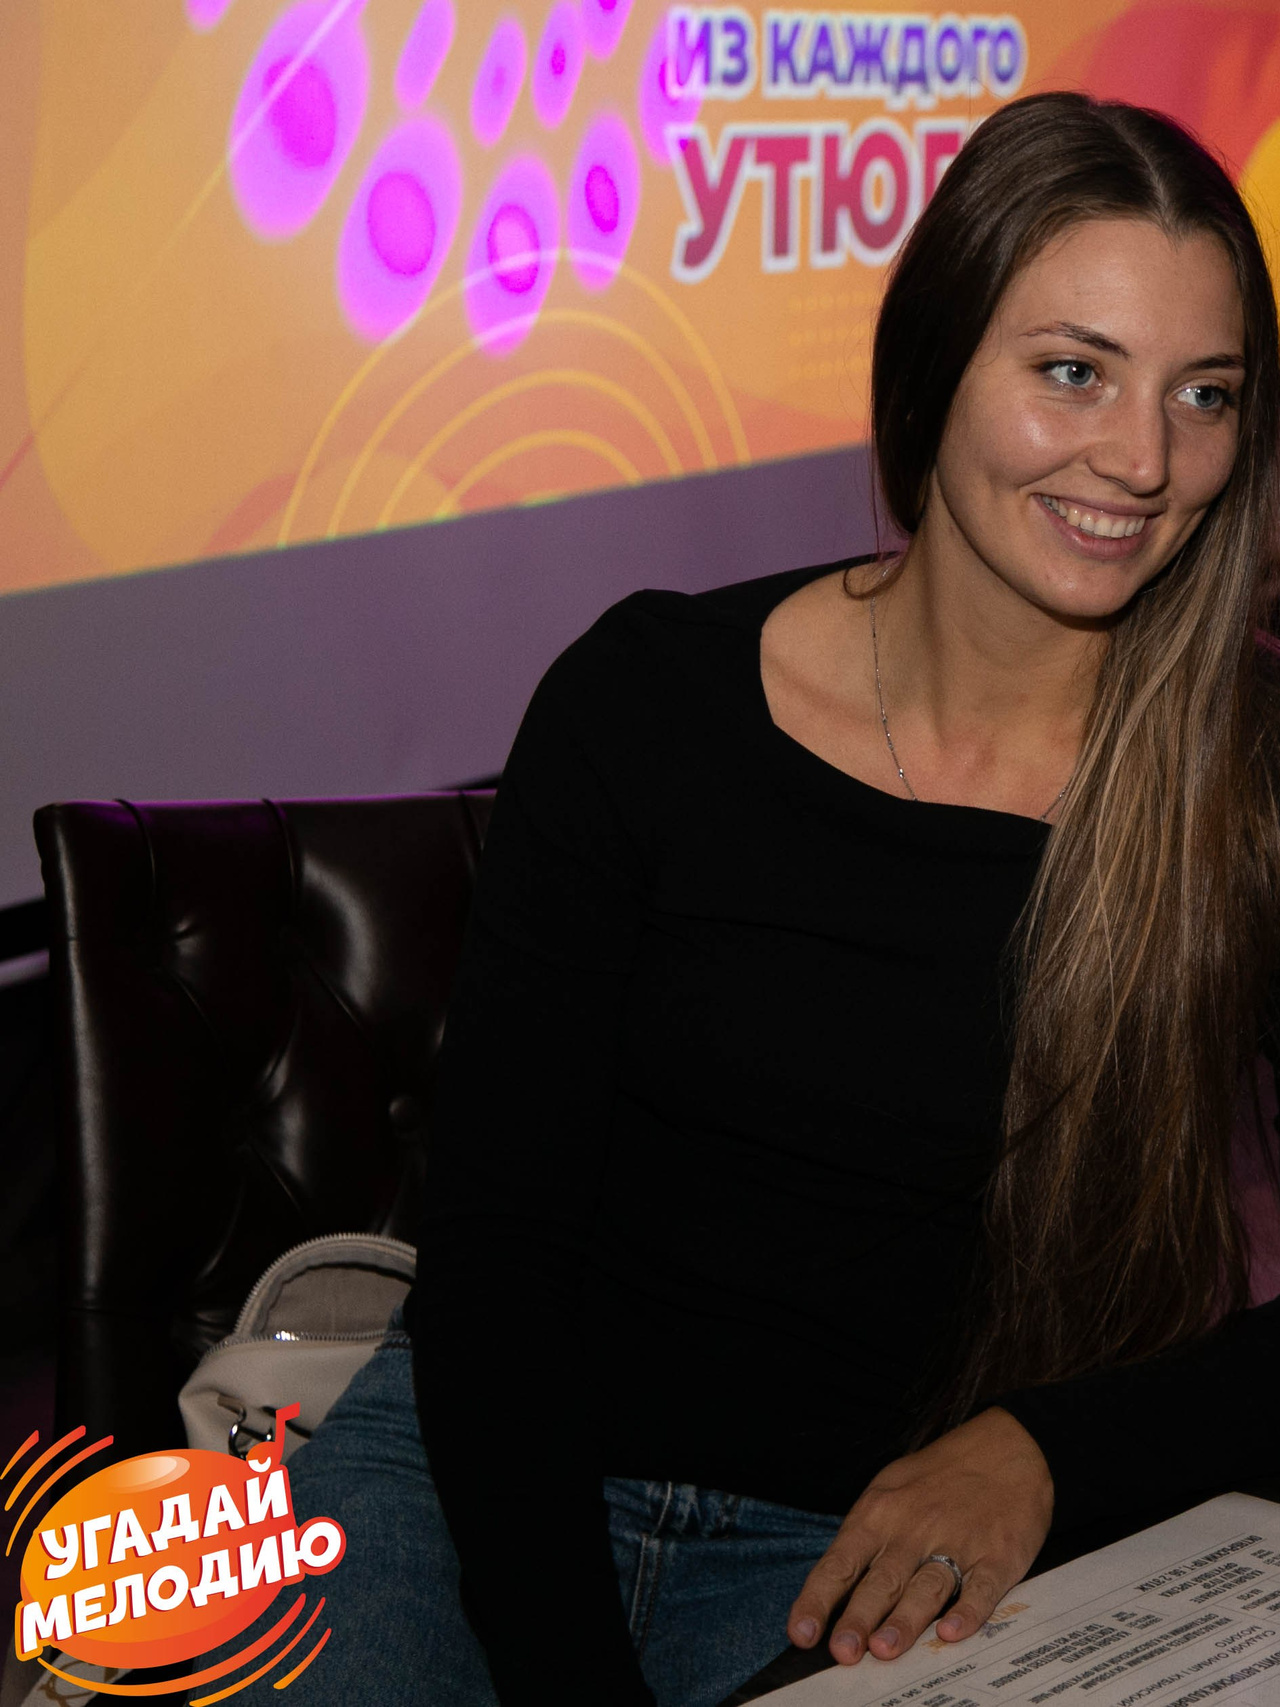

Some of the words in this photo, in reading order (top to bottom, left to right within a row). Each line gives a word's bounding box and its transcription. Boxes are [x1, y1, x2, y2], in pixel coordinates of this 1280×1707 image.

[673, 12, 749, 92] ИЗ
[768, 15, 1024, 105] КАЖДОГО
[668, 120, 966, 279] УТЮГ
[1210, 1625, 1263, 1647] МОХИТО
[1225, 1629, 1278, 1653] СЛАДКИЙ
[1185, 1652, 1231, 1671] ОЛИМП
[1114, 1673, 1185, 1706] КУБИНСКИЙ
[1201, 1666, 1262, 1692] АВТОРСКИЕ
